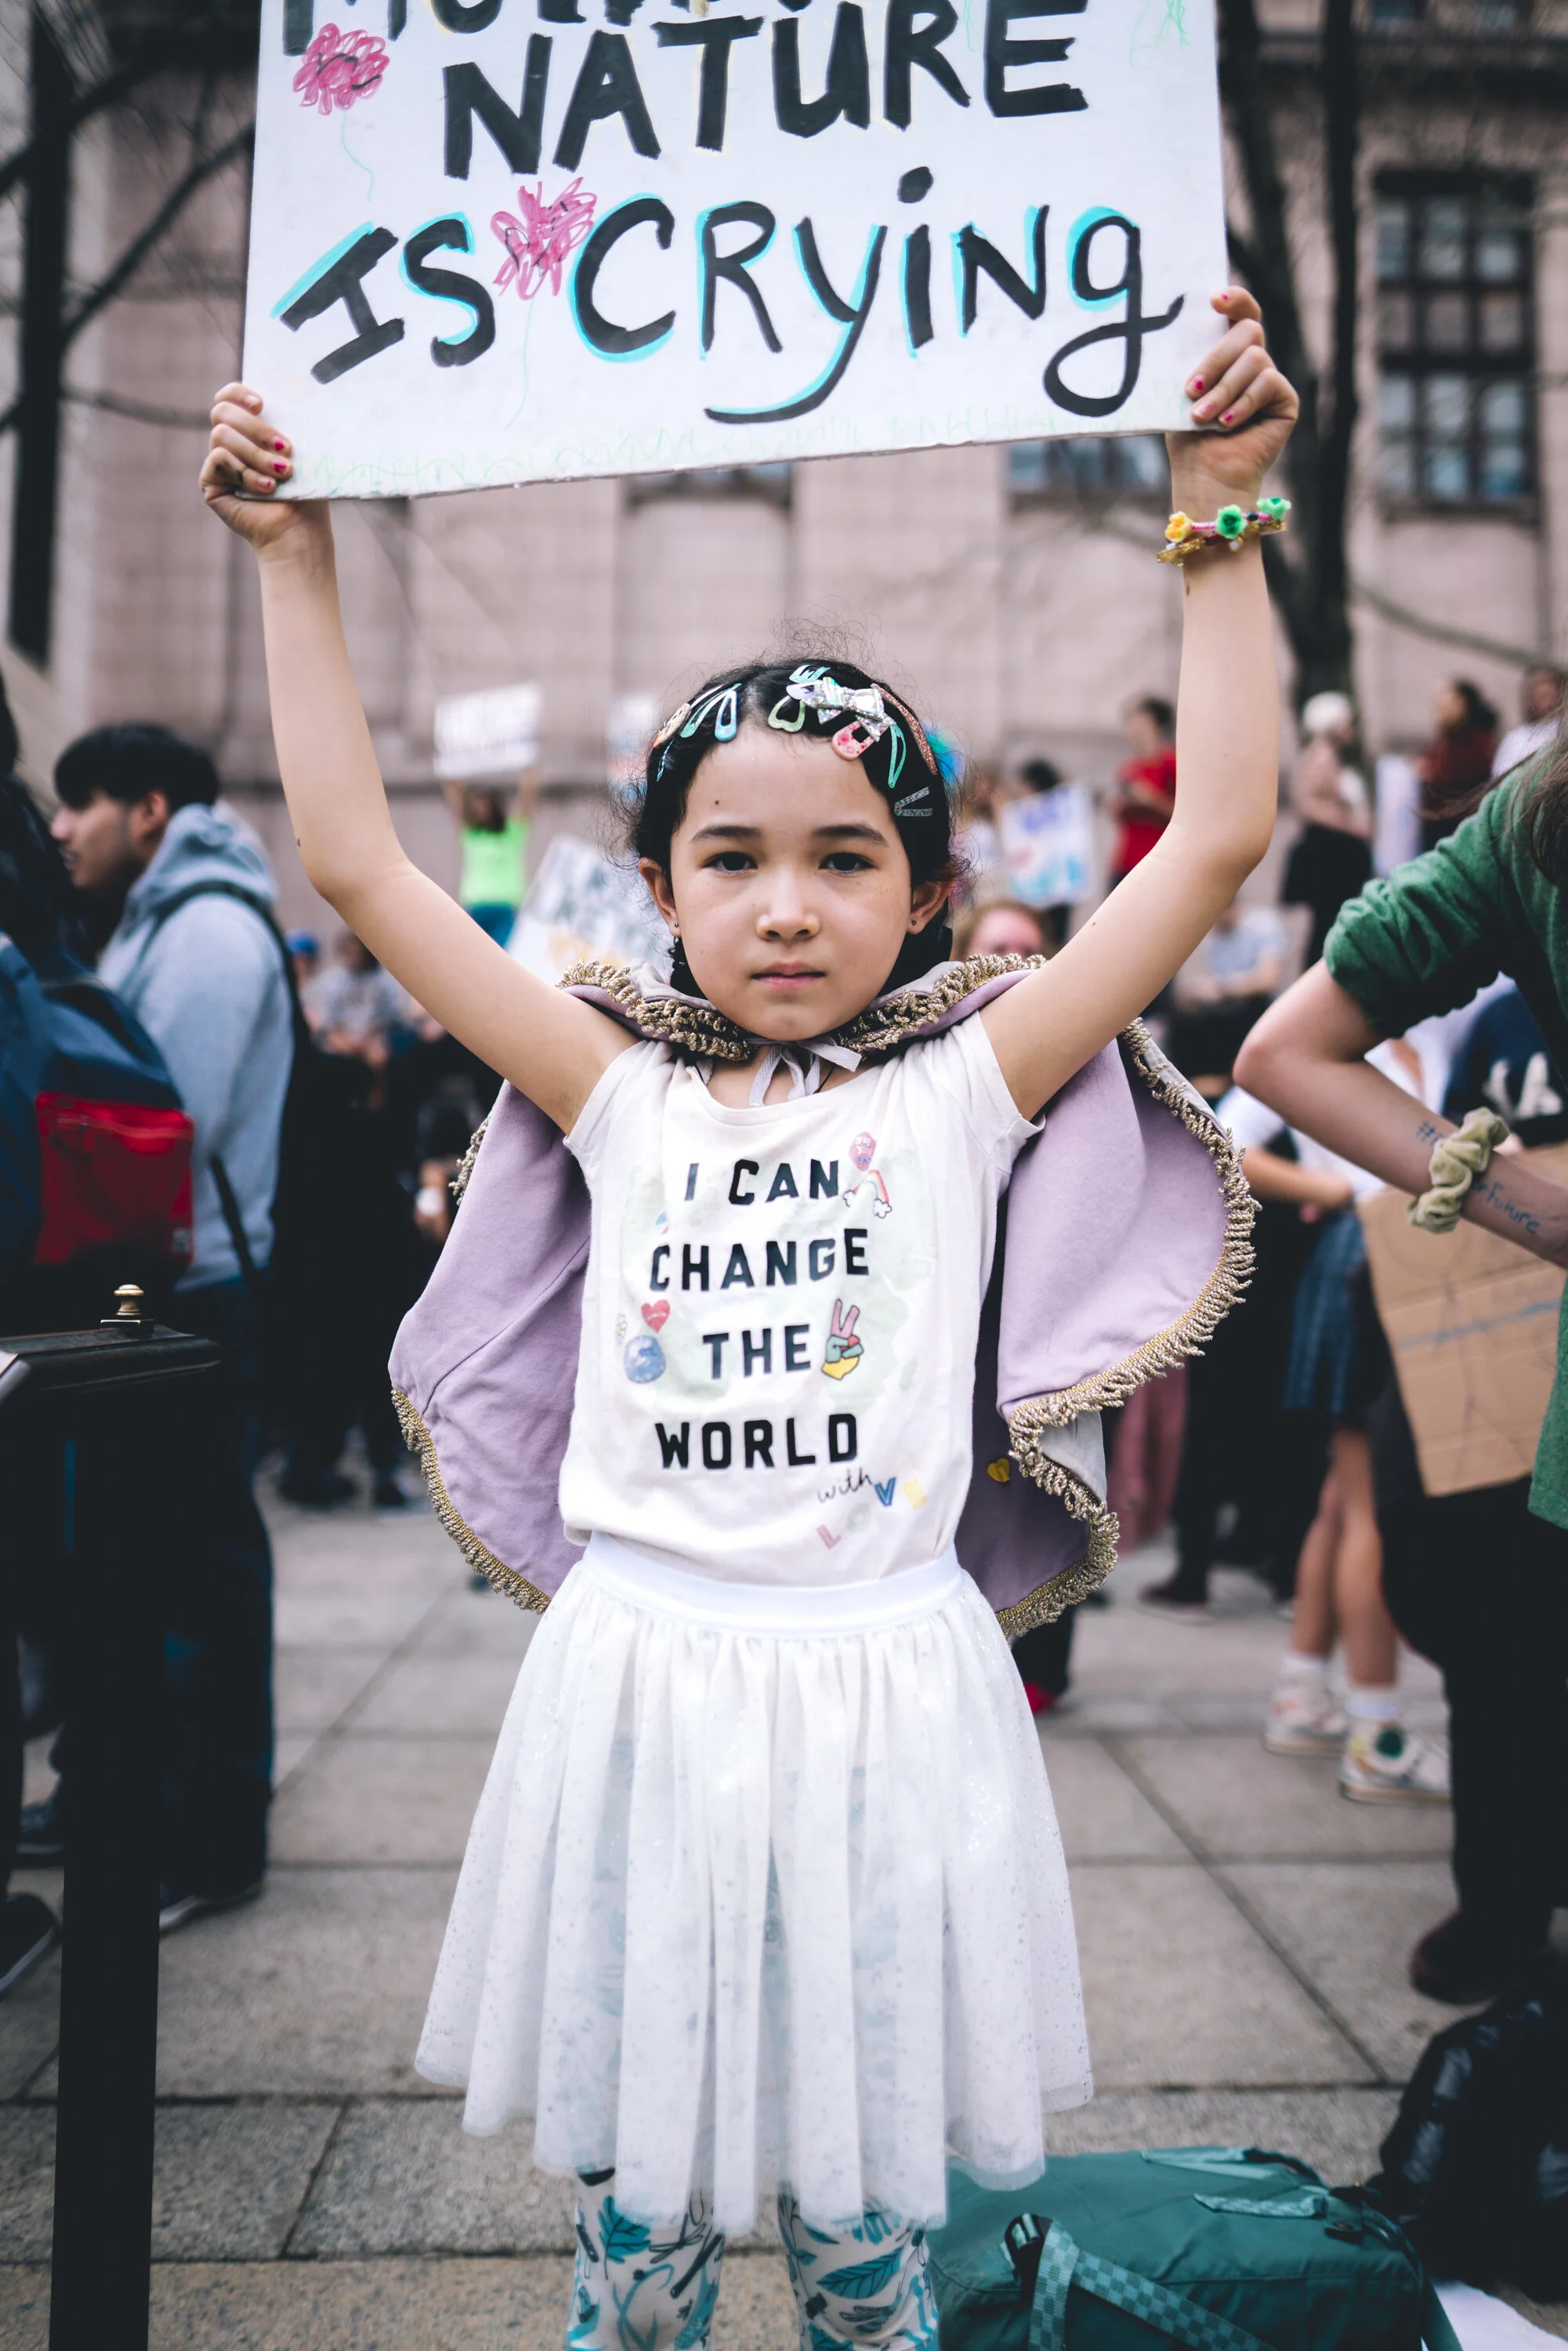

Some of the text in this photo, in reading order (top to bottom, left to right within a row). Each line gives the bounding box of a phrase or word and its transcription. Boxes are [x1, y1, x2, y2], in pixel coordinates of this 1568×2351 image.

[442, 0, 1088, 180] NATURE
[274, 213, 495, 384] IS
[684, 1159, 838, 1204] I CAN
[650, 1228, 869, 1291] CHANGE
[702, 1324, 810, 1379] THE
[655, 1413, 857, 1469] WORLD
[817, 1467, 872, 1504] with
